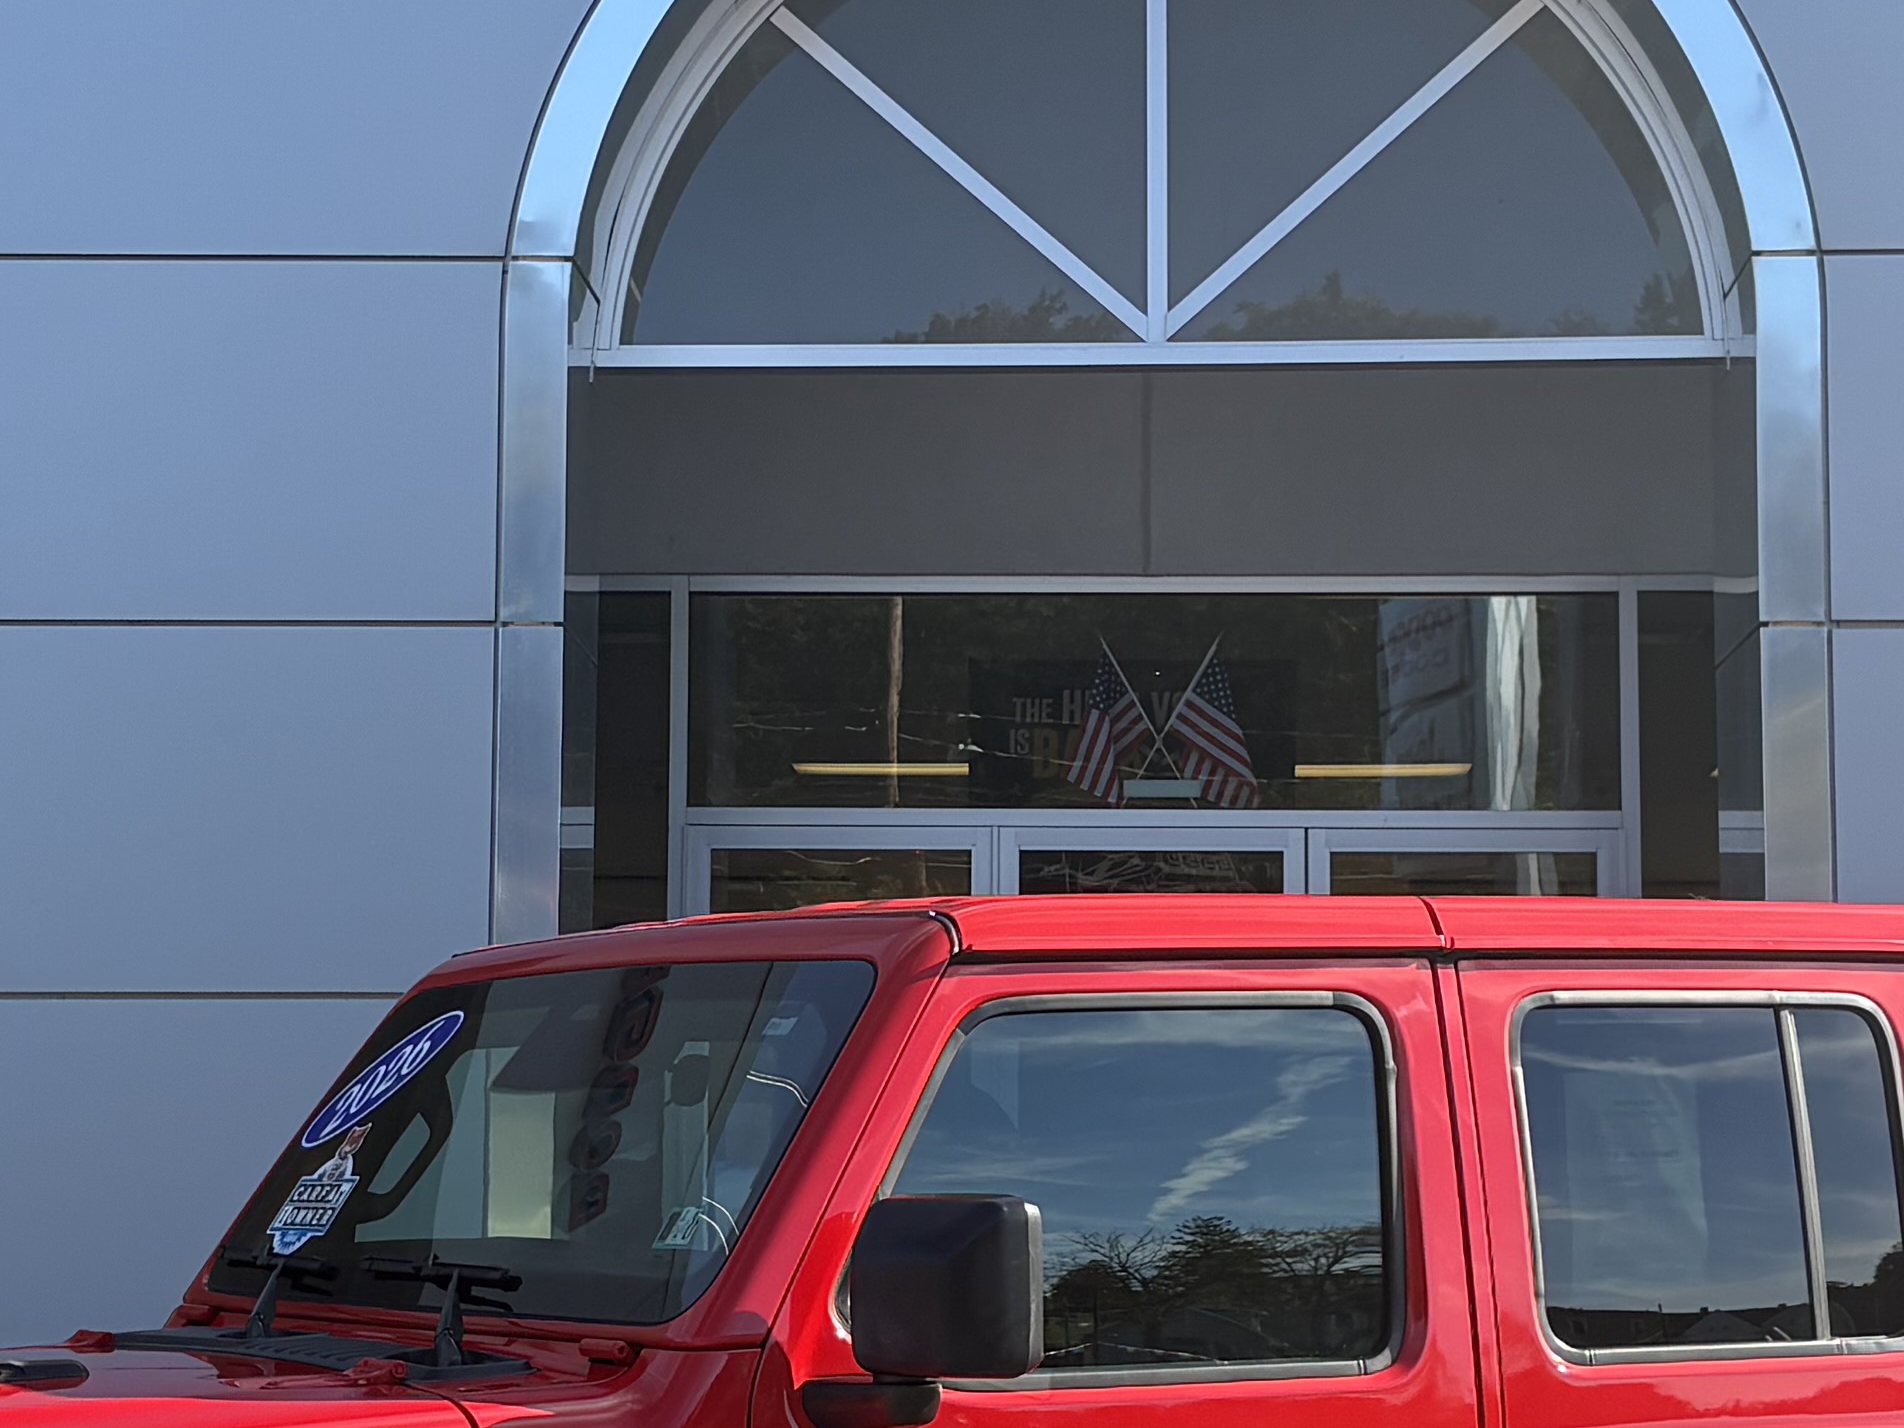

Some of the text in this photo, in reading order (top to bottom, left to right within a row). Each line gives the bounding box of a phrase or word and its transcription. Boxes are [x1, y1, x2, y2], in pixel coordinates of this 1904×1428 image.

[1011, 697, 1055, 724] THE
[1008, 728, 1031, 755] IS
[319, 1019, 446, 1139] 2026
